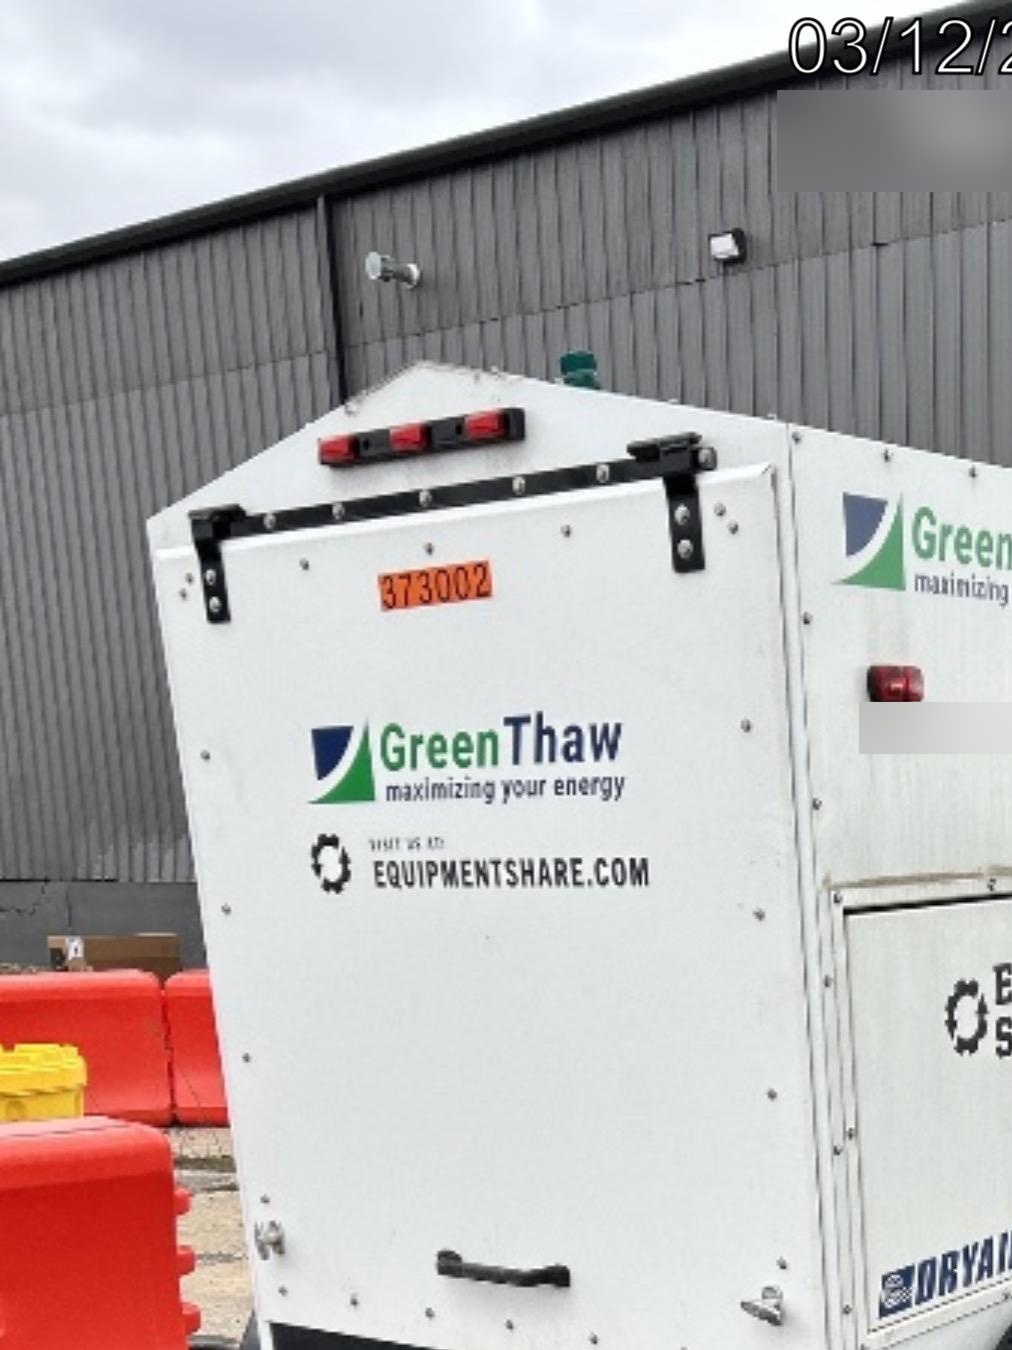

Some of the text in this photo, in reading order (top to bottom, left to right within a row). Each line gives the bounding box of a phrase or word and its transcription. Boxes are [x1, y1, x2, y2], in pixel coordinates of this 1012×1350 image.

[382, 563, 491, 609] 373002
[914, 573, 1008, 607] maximizing
[380, 711, 622, 772] GreenThaw
[386, 774, 625, 804] maximizing your energy
[373, 857, 650, 889] EQUIPMENTSHARE.COM
